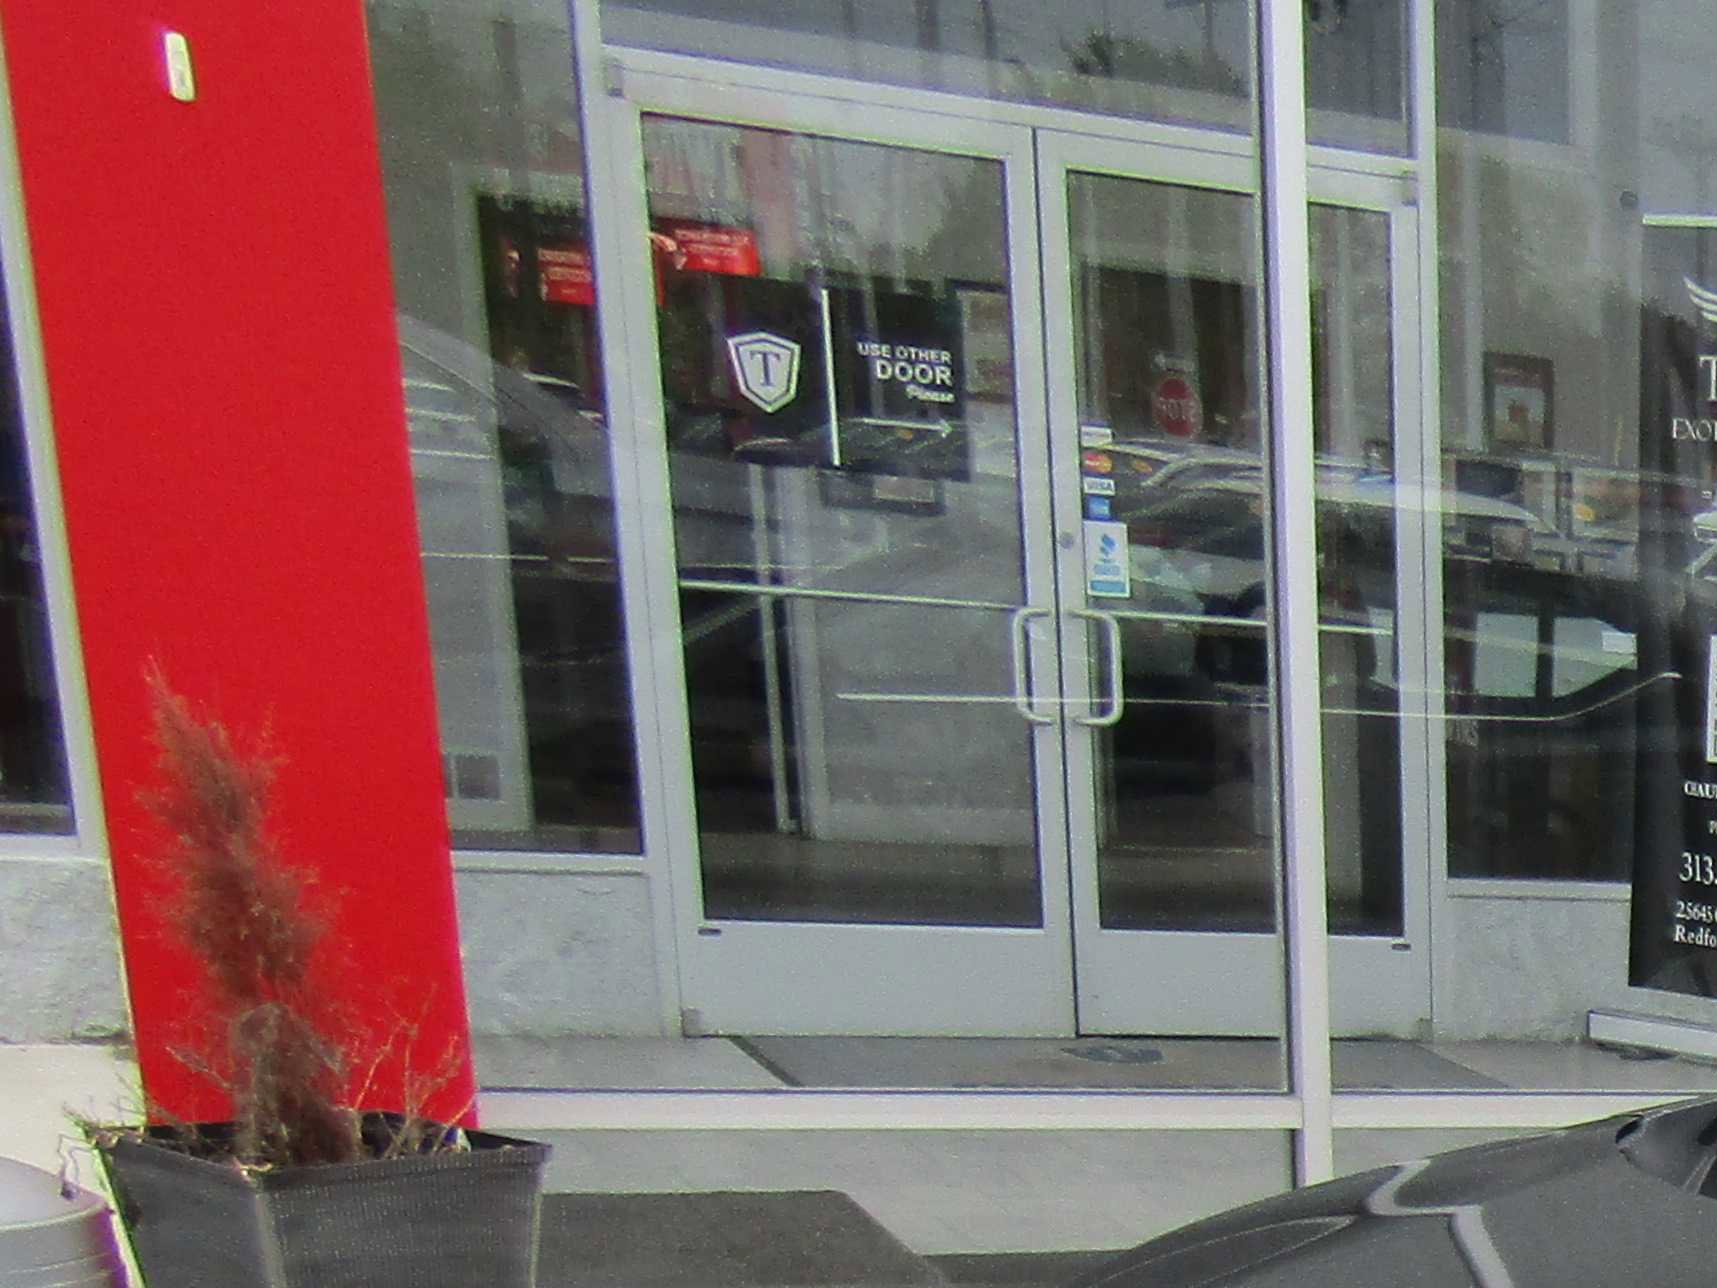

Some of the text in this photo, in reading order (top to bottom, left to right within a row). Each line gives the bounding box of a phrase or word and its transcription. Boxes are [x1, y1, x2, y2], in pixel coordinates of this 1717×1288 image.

[857, 342, 952, 364] USE OTHER
[751, 351, 781, 388] T
[876, 360, 952, 386] DOOR
[1675, 901, 1714, 923] 25645
